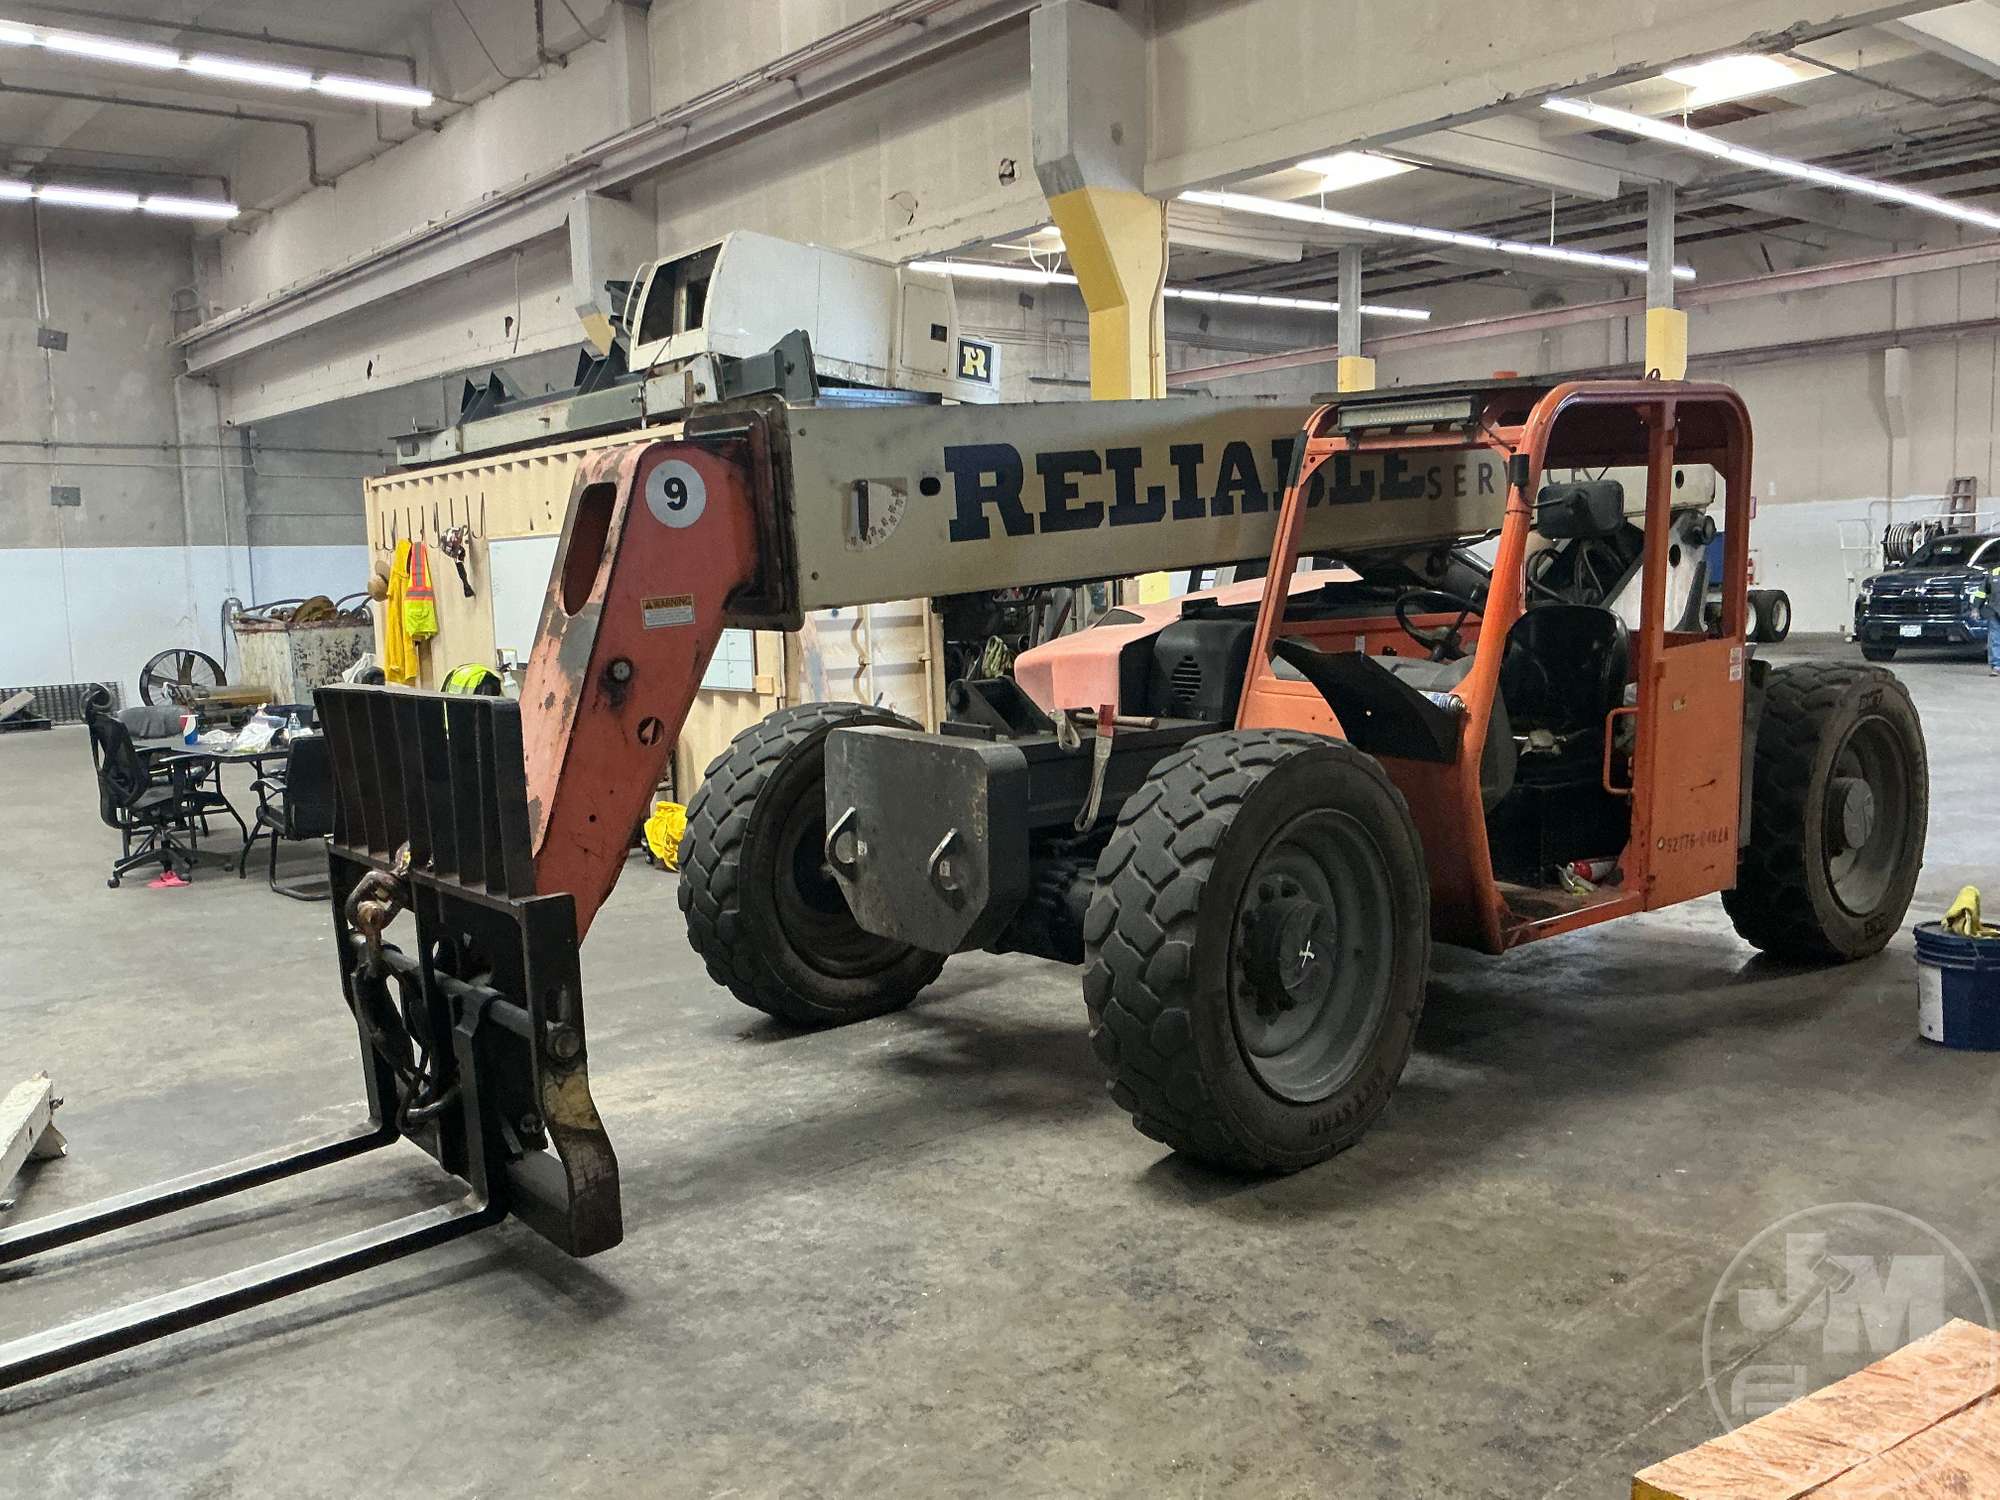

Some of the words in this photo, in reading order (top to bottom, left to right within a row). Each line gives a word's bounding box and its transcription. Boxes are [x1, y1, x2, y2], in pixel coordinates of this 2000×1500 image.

[963, 346, 987, 378] R
[664, 477, 688, 511] 9
[944, 438, 1426, 542] RELIABLE
